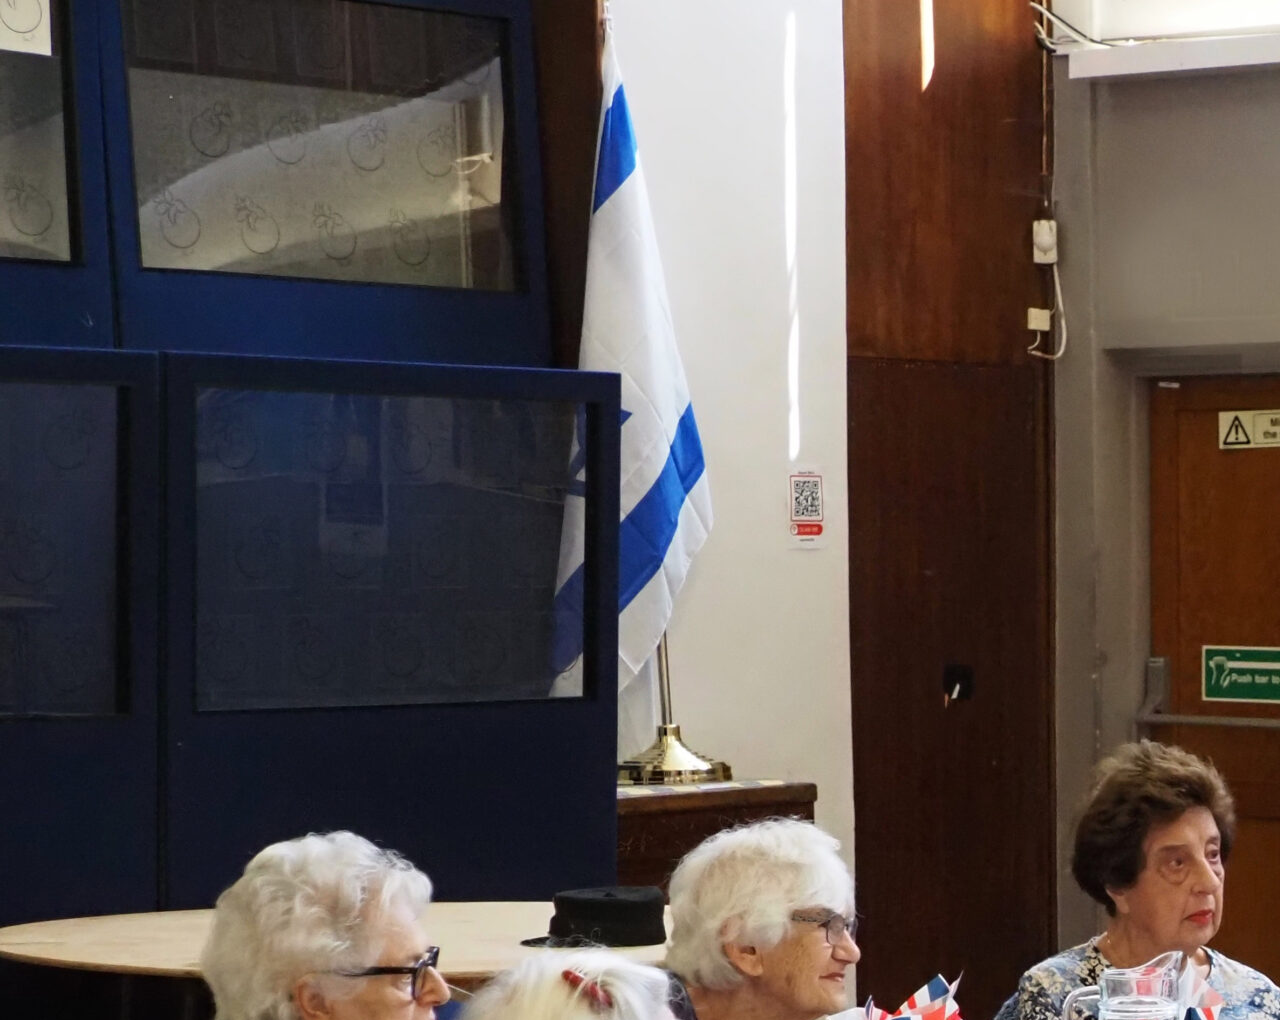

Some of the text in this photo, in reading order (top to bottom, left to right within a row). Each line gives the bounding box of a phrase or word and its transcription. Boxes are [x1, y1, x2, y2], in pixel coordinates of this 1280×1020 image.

[1263, 430, 1278, 439] the
[1230, 672, 1253, 683] Push
[1254, 673, 1269, 684] bar
[1271, 674, 1280, 684] to
